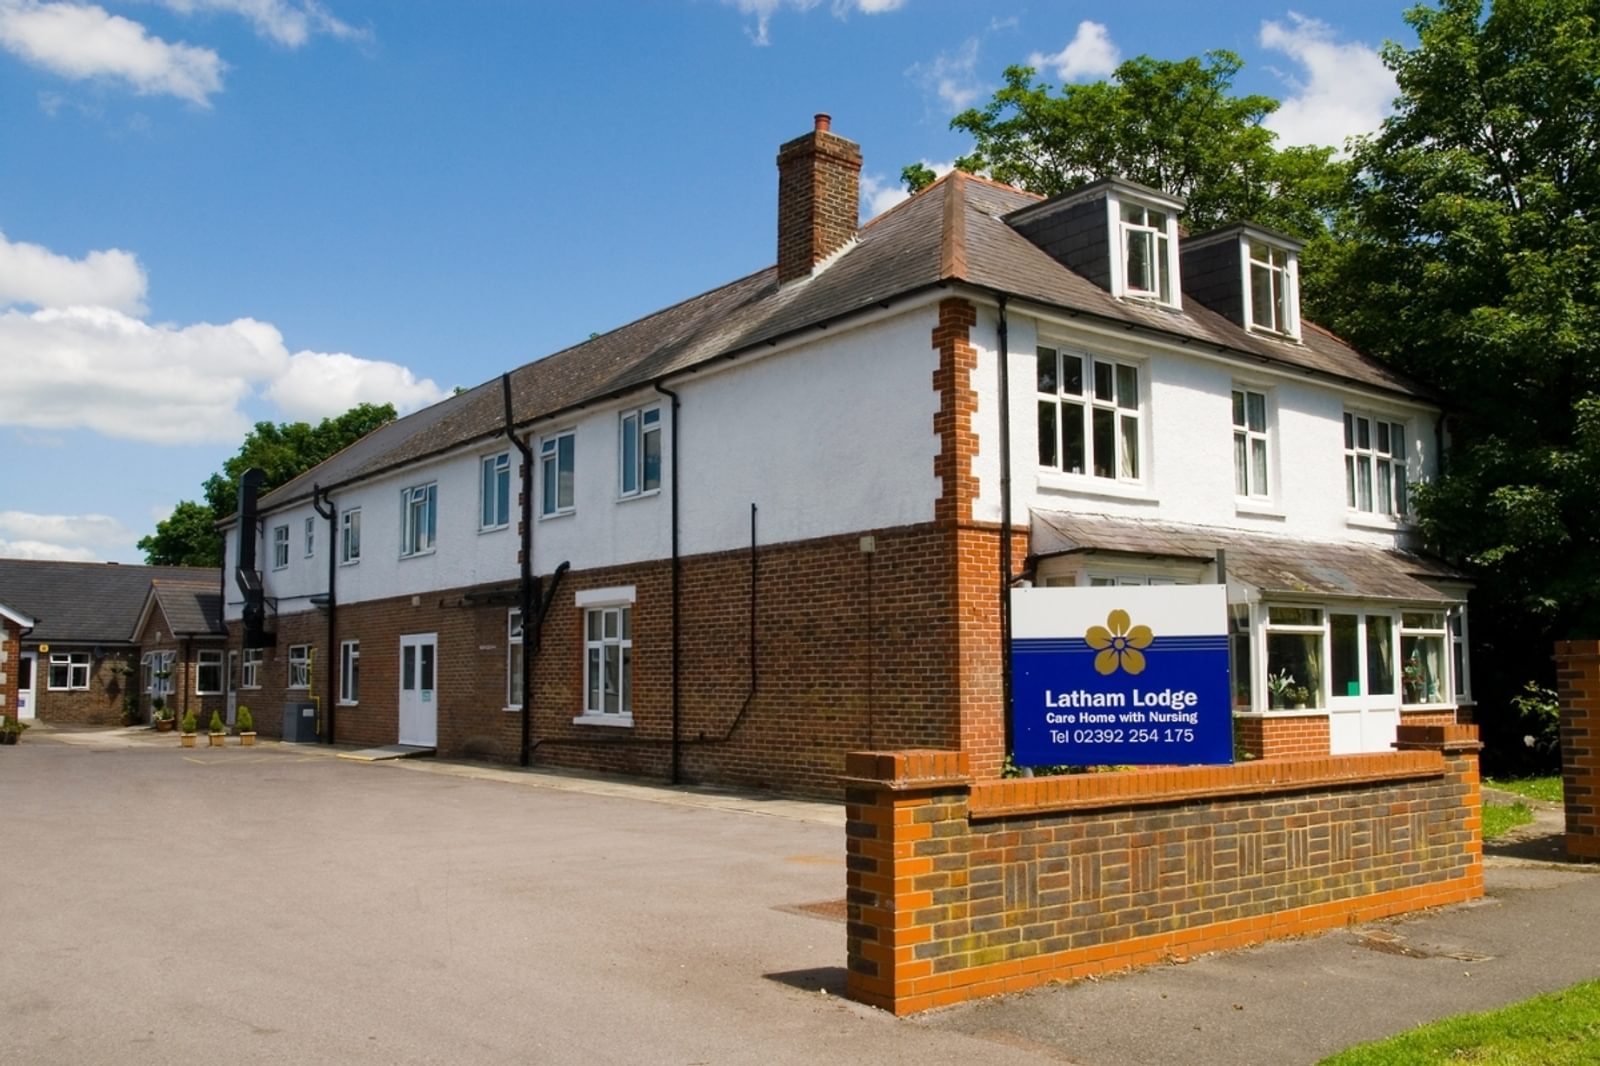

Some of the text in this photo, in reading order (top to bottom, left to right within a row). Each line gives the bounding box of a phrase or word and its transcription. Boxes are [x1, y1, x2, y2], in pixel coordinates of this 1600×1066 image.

[1046, 689, 1198, 709] Latham Lodge
[1046, 711, 1198, 724] Care Home with Nursing
[1050, 729, 1194, 743] Tel 02392 254 175
